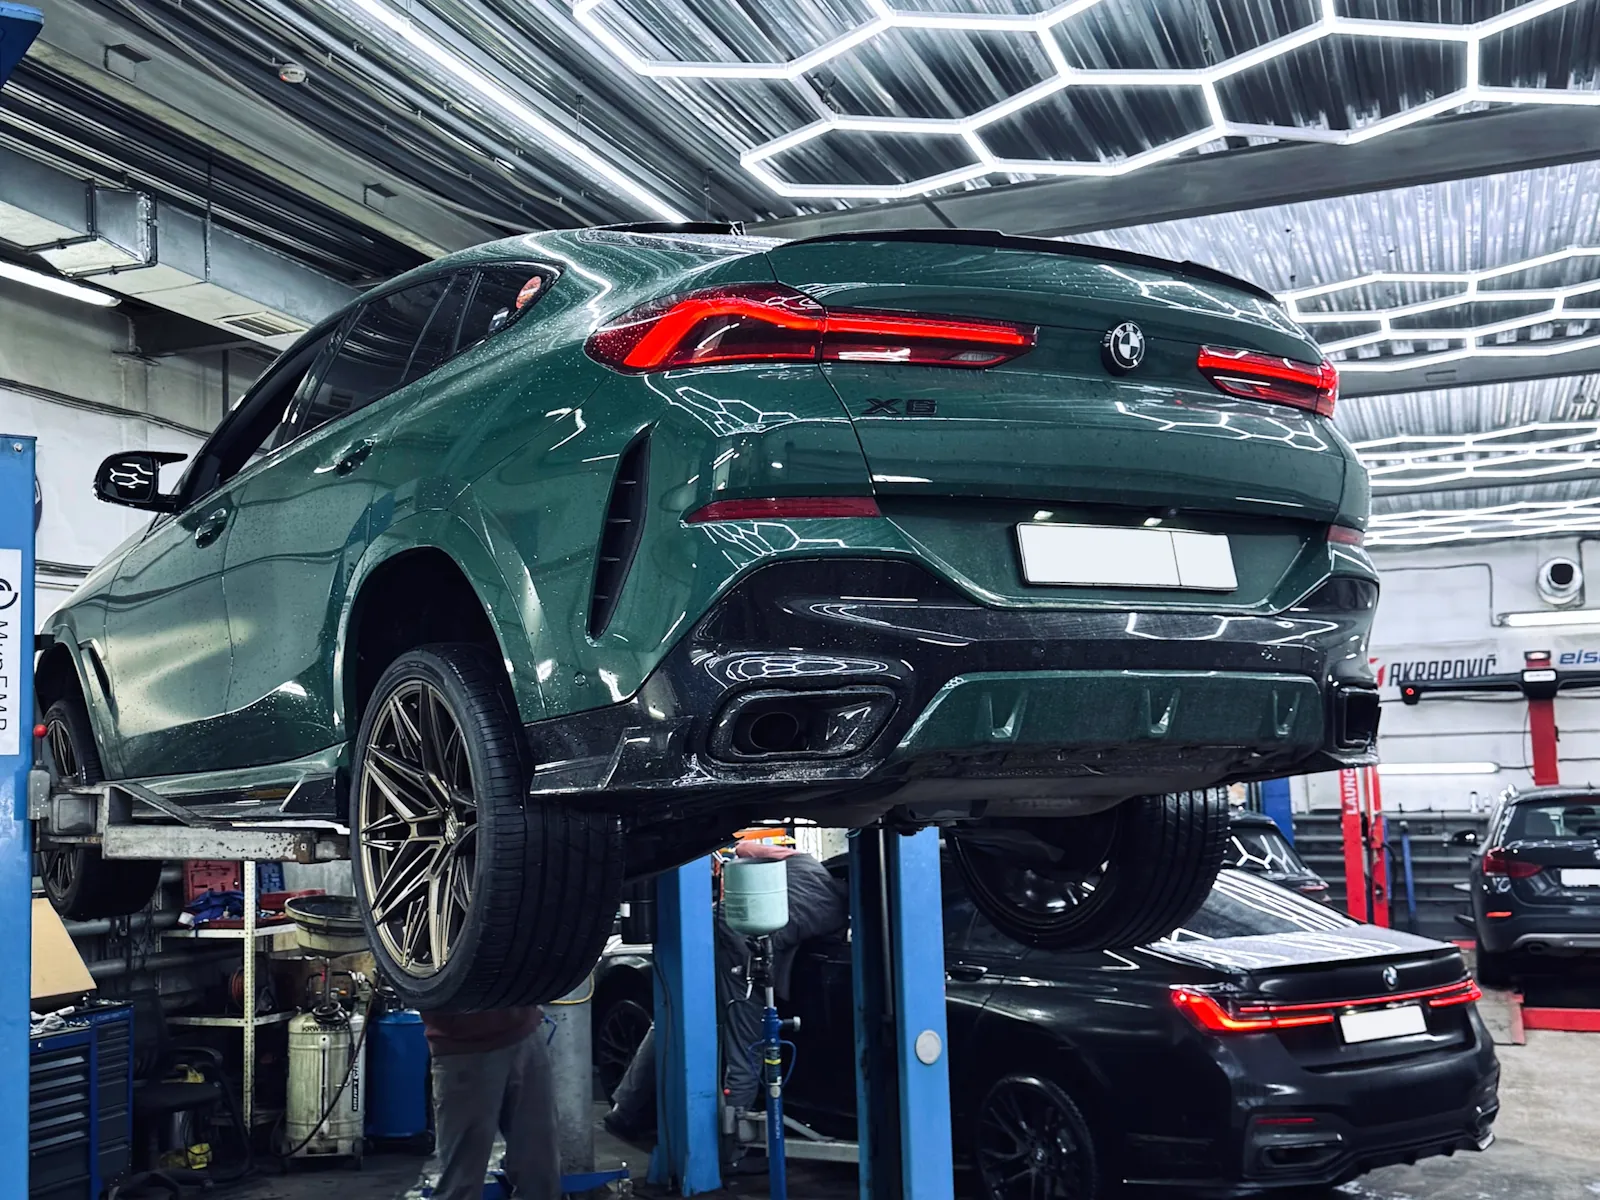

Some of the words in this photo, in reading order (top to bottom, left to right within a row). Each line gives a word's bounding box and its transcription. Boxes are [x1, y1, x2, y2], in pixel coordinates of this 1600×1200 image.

[861, 398, 937, 416] X6
[1559, 649, 1600, 665] els
[1343, 768, 1358, 815] LAUNC
